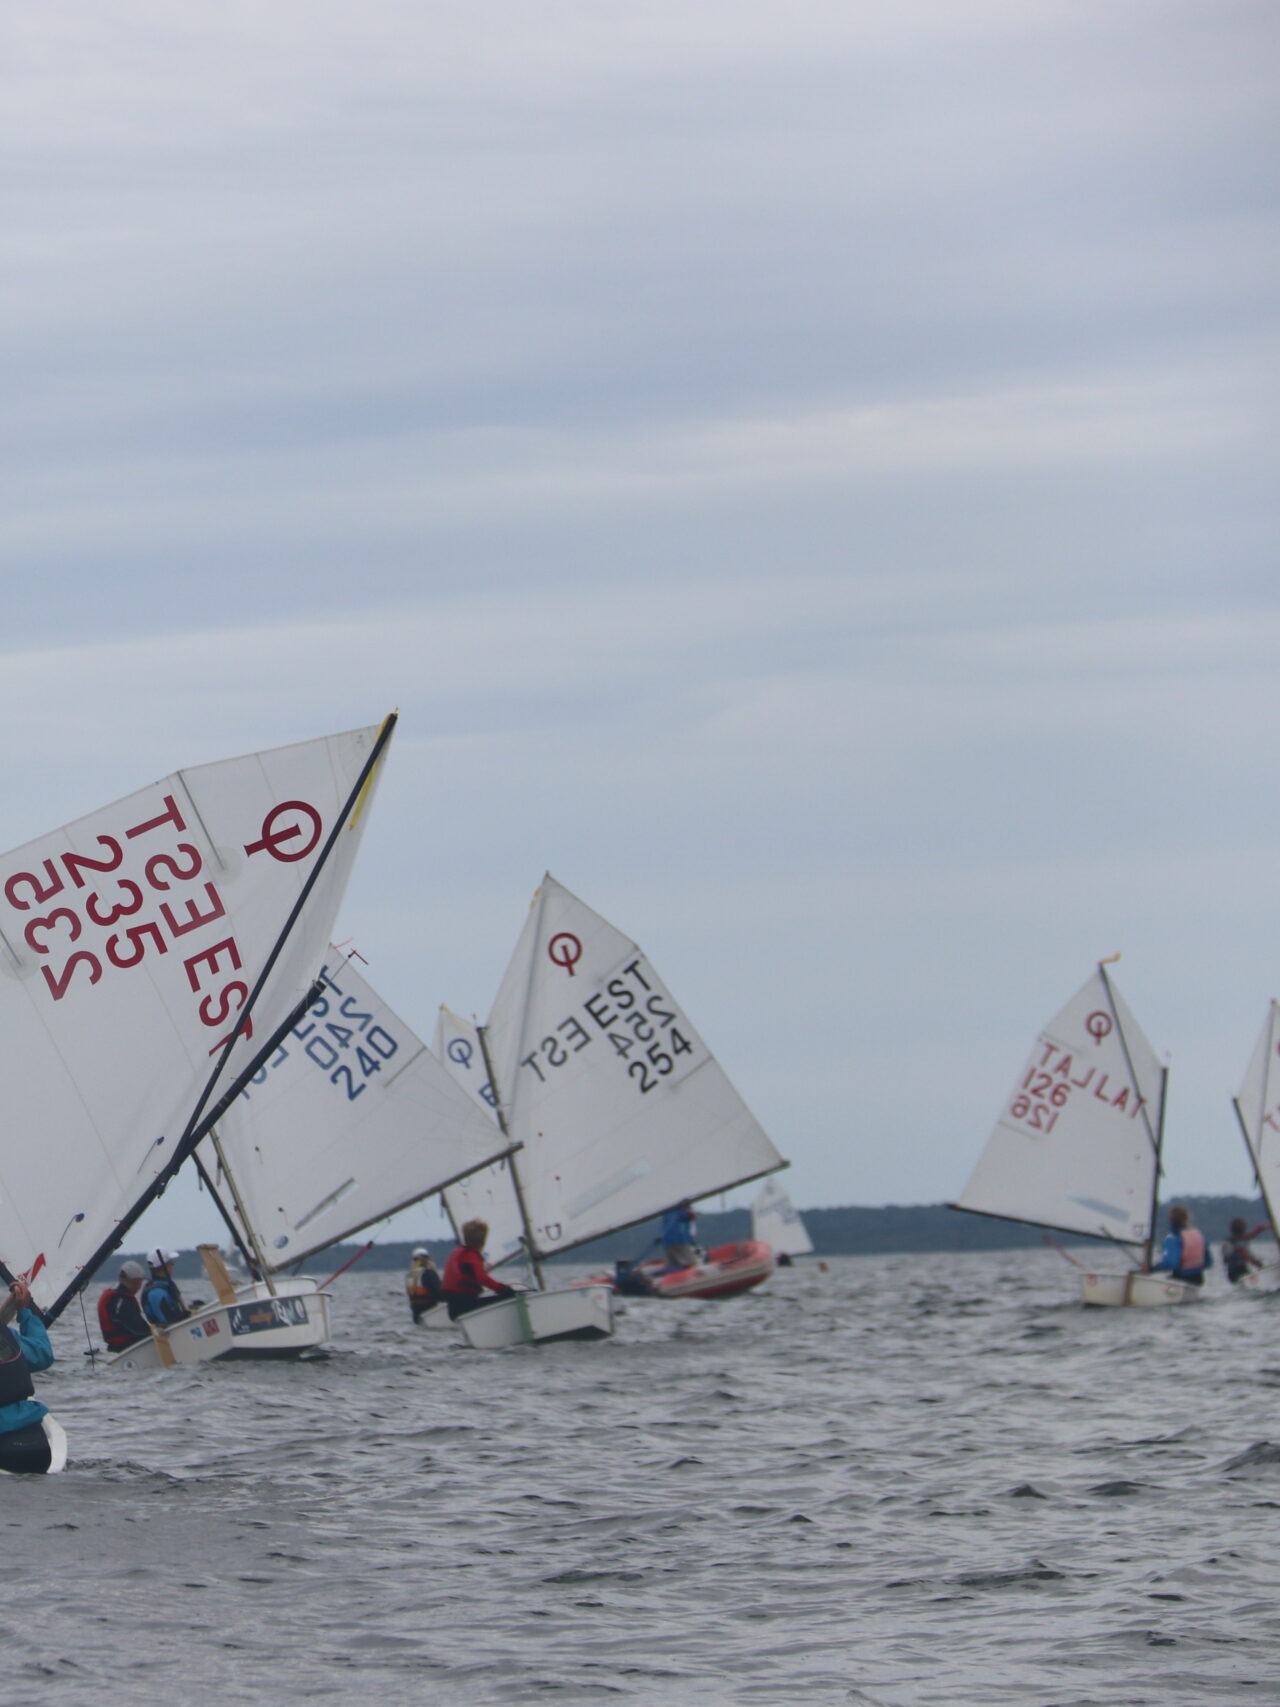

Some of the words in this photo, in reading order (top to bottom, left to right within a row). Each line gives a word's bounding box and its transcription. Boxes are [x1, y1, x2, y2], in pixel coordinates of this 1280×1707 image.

[60, 835, 168, 969] 235
[583, 960, 652, 1030] EST
[328, 1025, 399, 1101] 240
[627, 1027, 694, 1094] 254
[1020, 1067, 1072, 1109] 126
